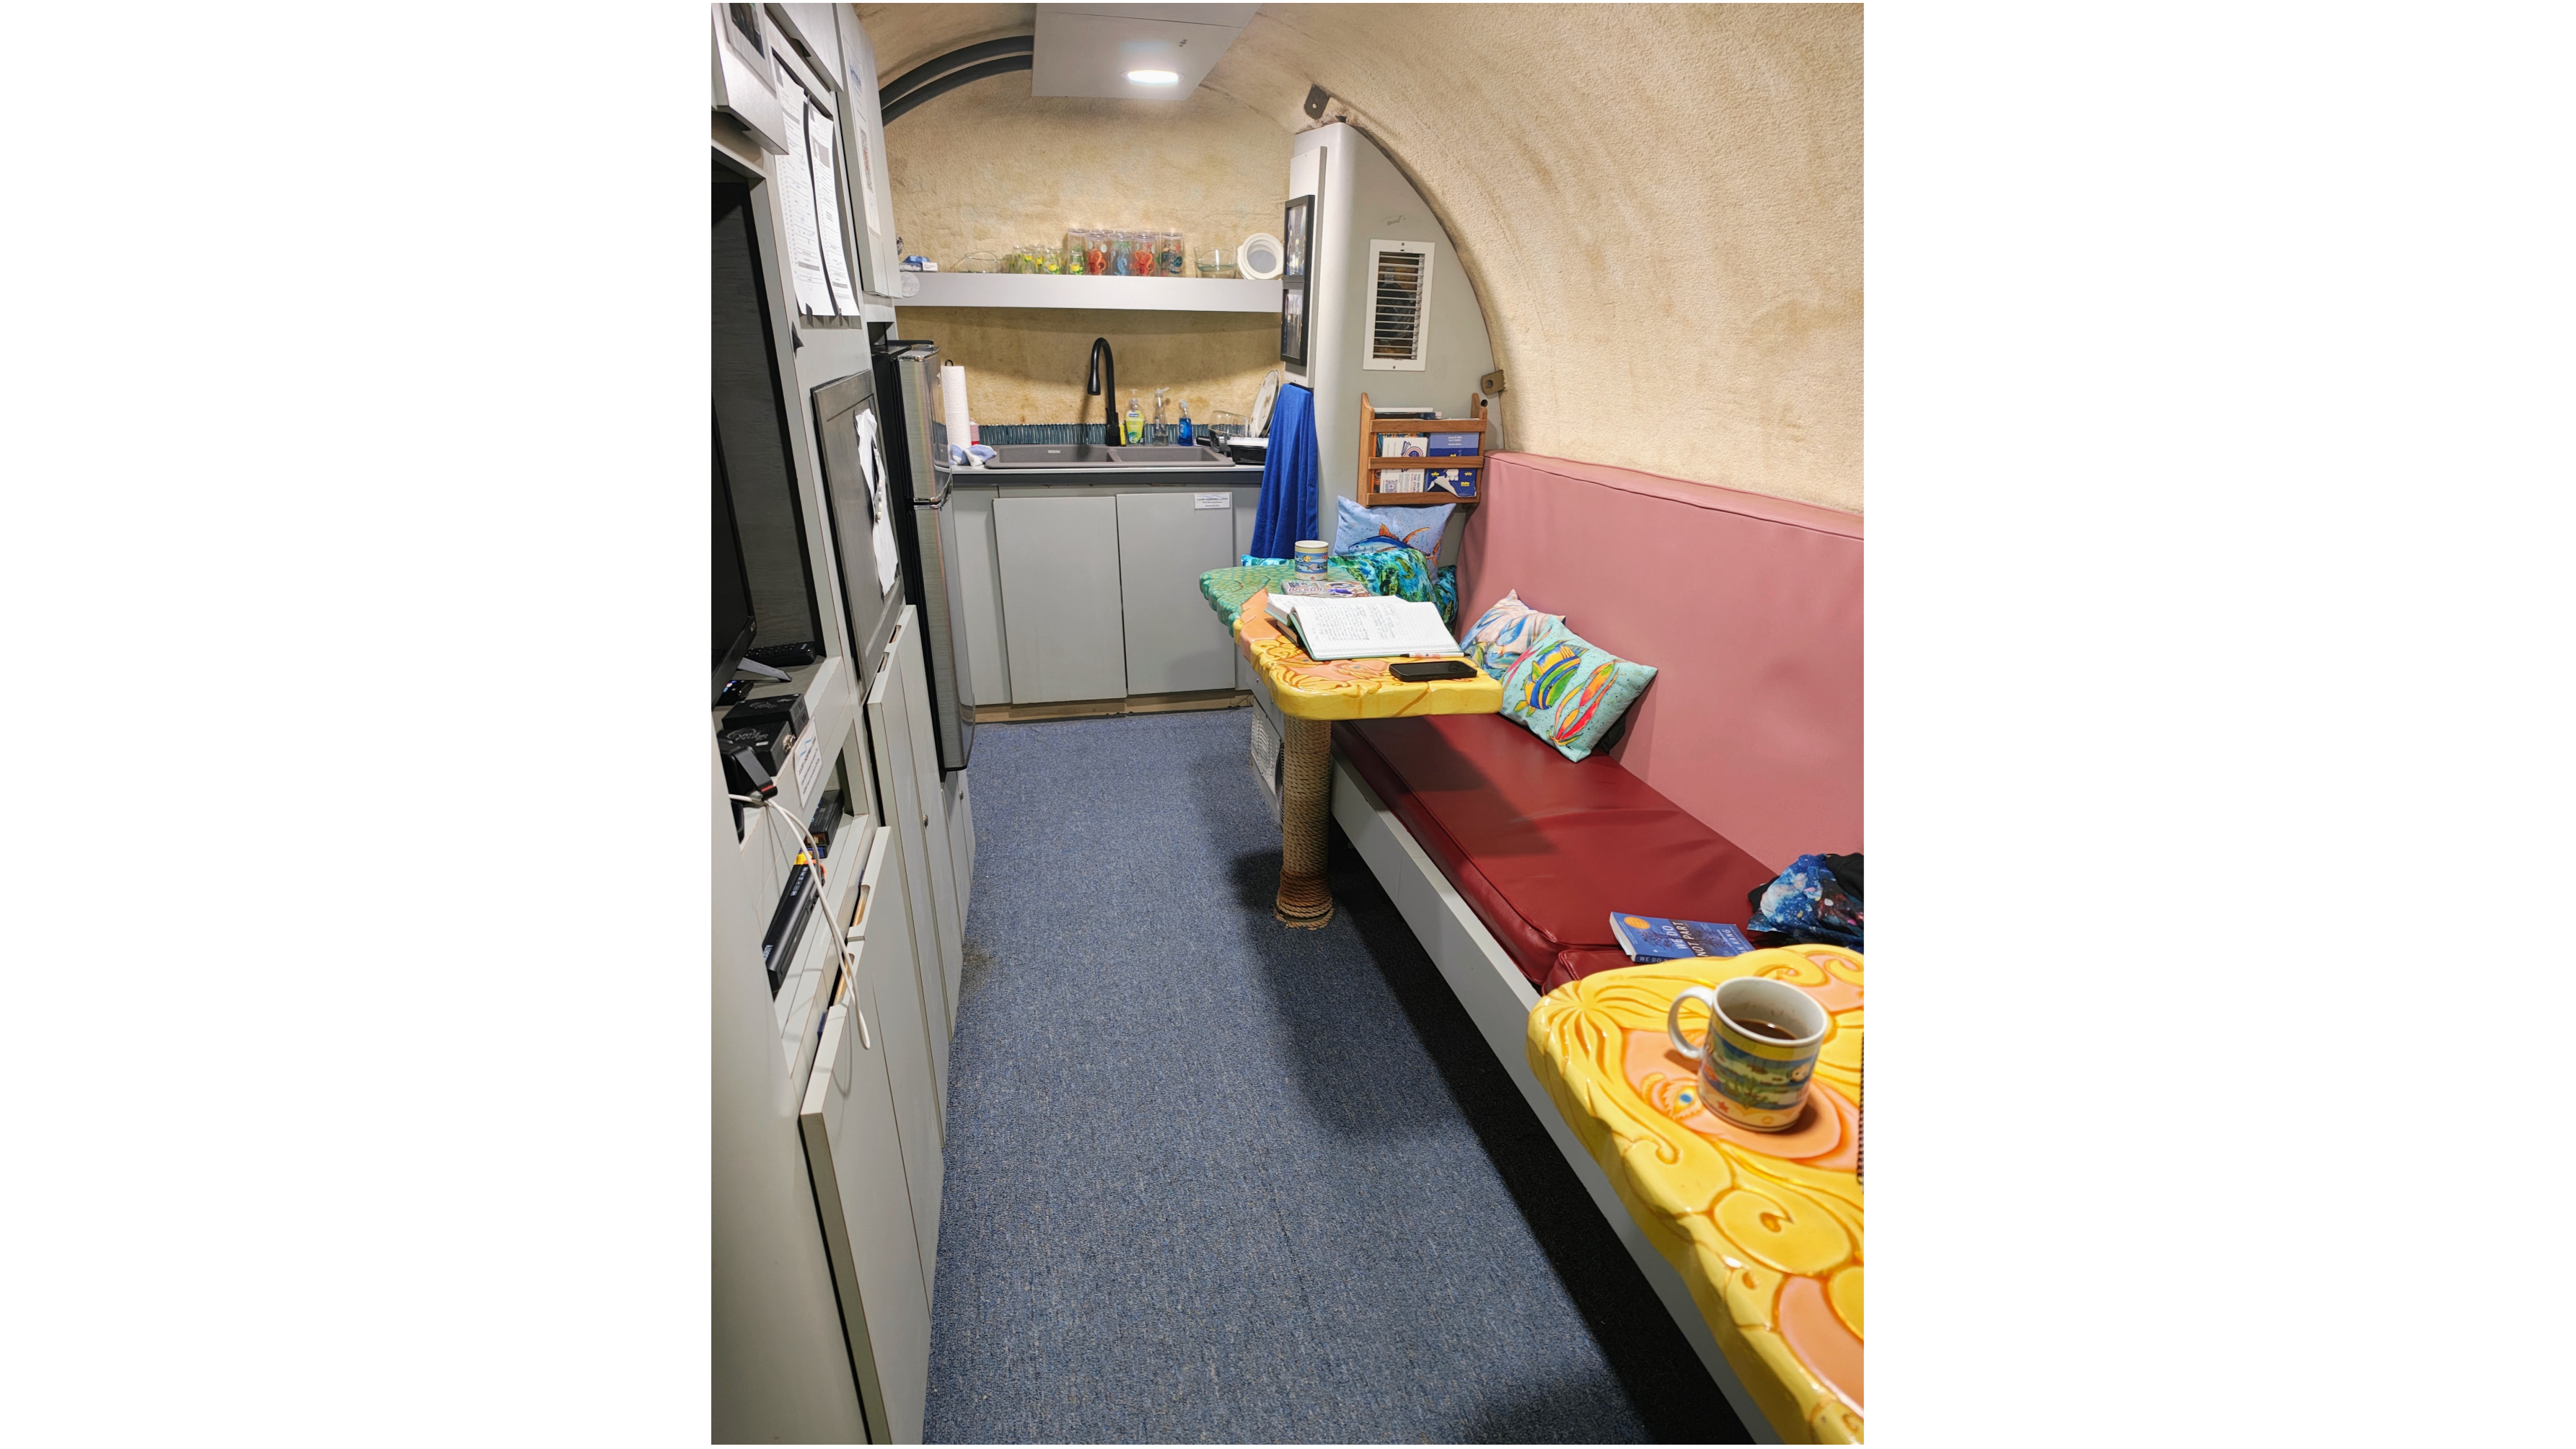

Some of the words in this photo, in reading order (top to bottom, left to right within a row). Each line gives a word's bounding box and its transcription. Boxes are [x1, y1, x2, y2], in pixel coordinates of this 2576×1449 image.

[1662, 925, 1678, 936] DO
[1672, 921, 1694, 940] PART
[1722, 930, 1741, 945] KANG
[1670, 938, 1688, 949] WE
[1687, 941, 1708, 956] NOT
